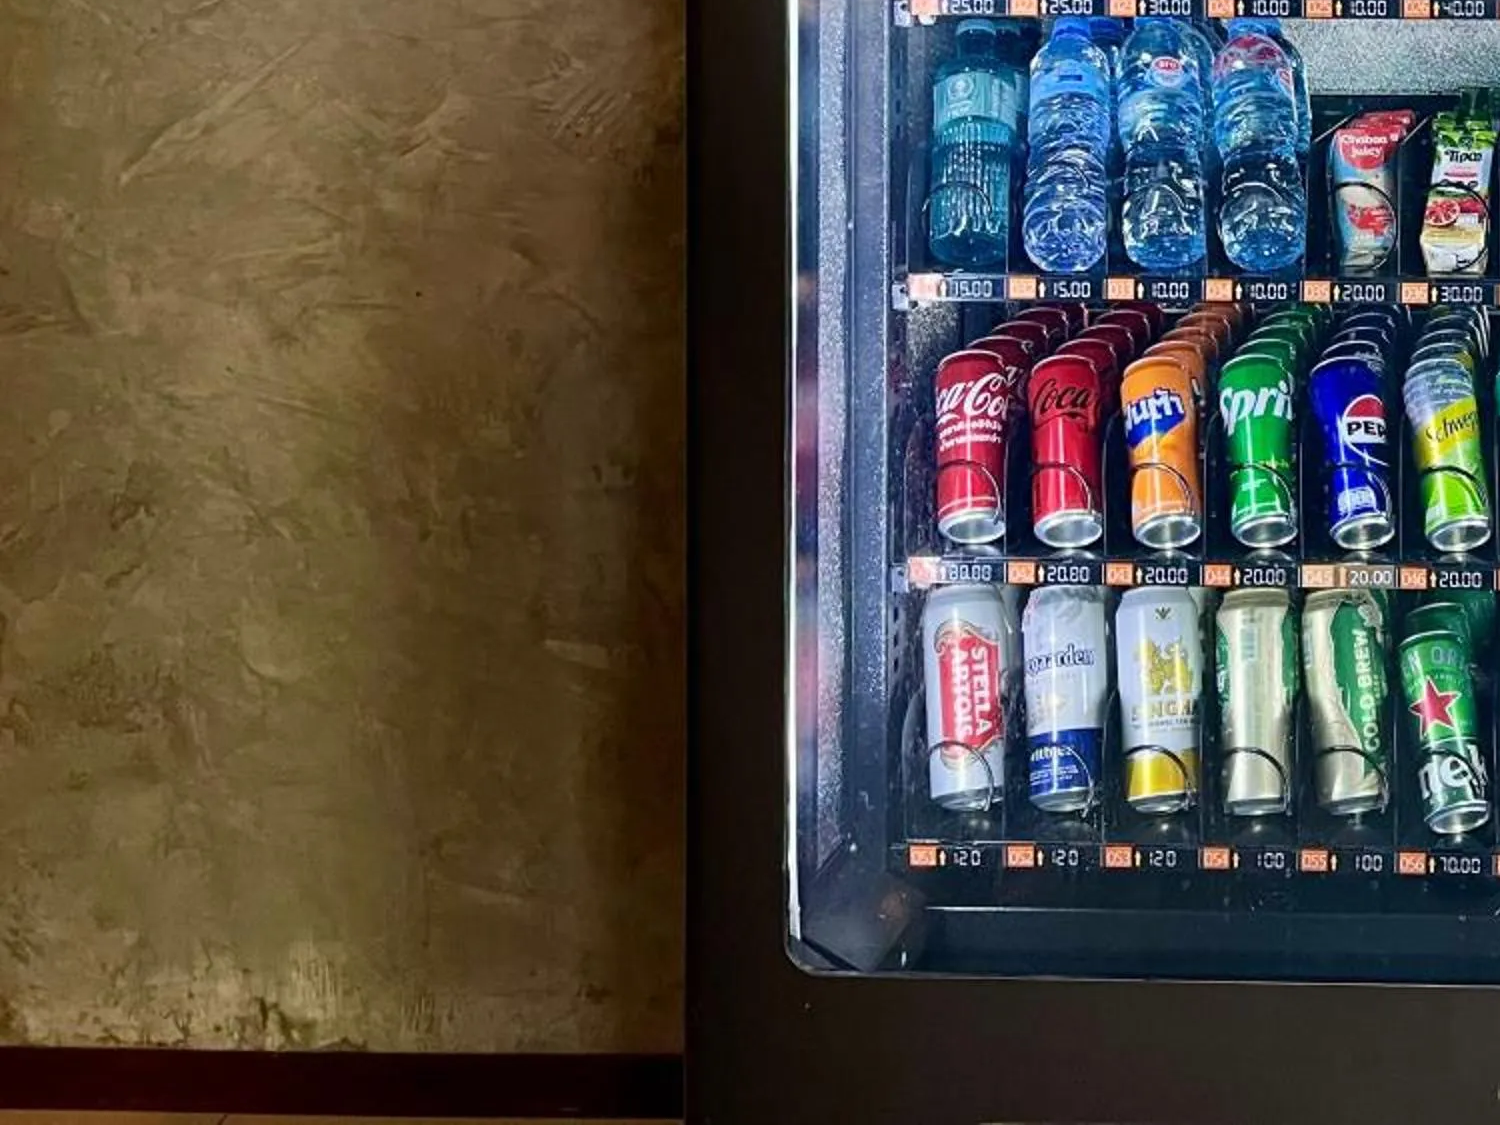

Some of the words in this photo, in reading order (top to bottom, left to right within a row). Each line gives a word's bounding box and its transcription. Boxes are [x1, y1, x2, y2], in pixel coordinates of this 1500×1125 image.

[1252, 0, 1289, 16] 10.00
[1350, 0, 1386, 16] 10.00
[1054, 282, 1091, 298] 15.00
[1343, 284, 1385, 301] 20.00
[1441, 286, 1482, 303] 30.00
[1145, 567, 1188, 584] 20.00
[1243, 568, 1286, 585] 20.00
[1350, 570, 1392, 584] 20.00
[1439, 571, 1482, 588] 20.00
[1352, 628, 1373, 689] BREW
[971, 645, 994, 736] STELLA
[1359, 693, 1381, 753] COLD
[1052, 849, 1079, 866] 120
[1150, 851, 1177, 867] 120
[1355, 854, 1383, 871] 100
[1440, 857, 1481, 874] 70.00
